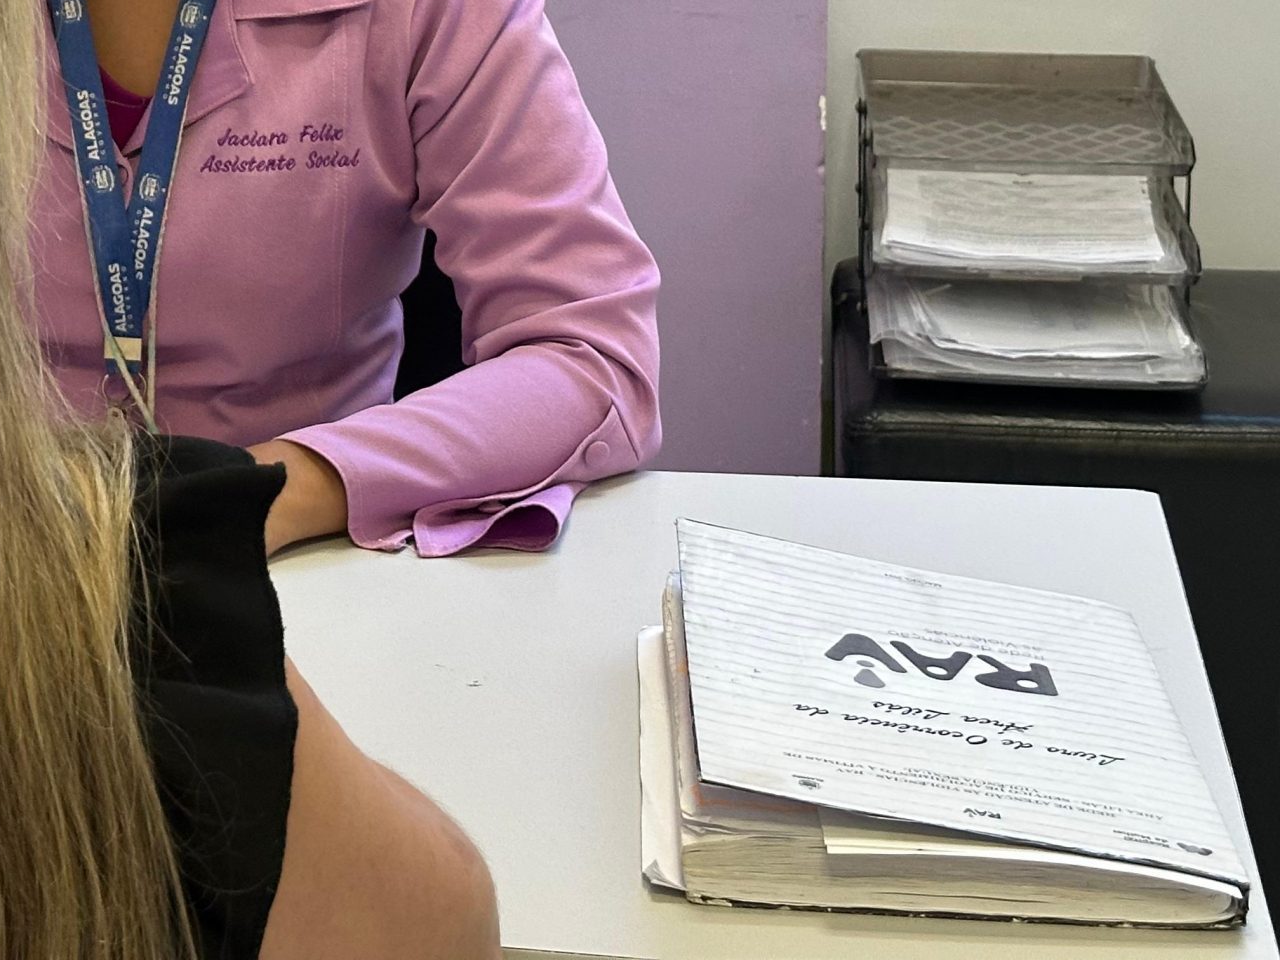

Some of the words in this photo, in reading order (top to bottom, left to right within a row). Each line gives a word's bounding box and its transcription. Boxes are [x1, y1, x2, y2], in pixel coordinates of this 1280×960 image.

[167, 33, 193, 106] ALAGOAS
[77, 90, 100, 161] ALAGOAS
[217, 127, 288, 147] Jaciara
[299, 123, 344, 143] Felix
[200, 154, 296, 173] Assistente
[306, 148, 361, 169] Social
[108, 262, 128, 333] ALAGOAS
[824, 634, 1058, 696] RAV
[793, 703, 829, 716] da
[872, 701, 950, 720] Lilás
[841, 713, 988, 745] Ocorrência
[961, 715, 1034, 734] Área
[1001, 739, 1033, 750] de
[1046, 747, 1125, 766] Livro
